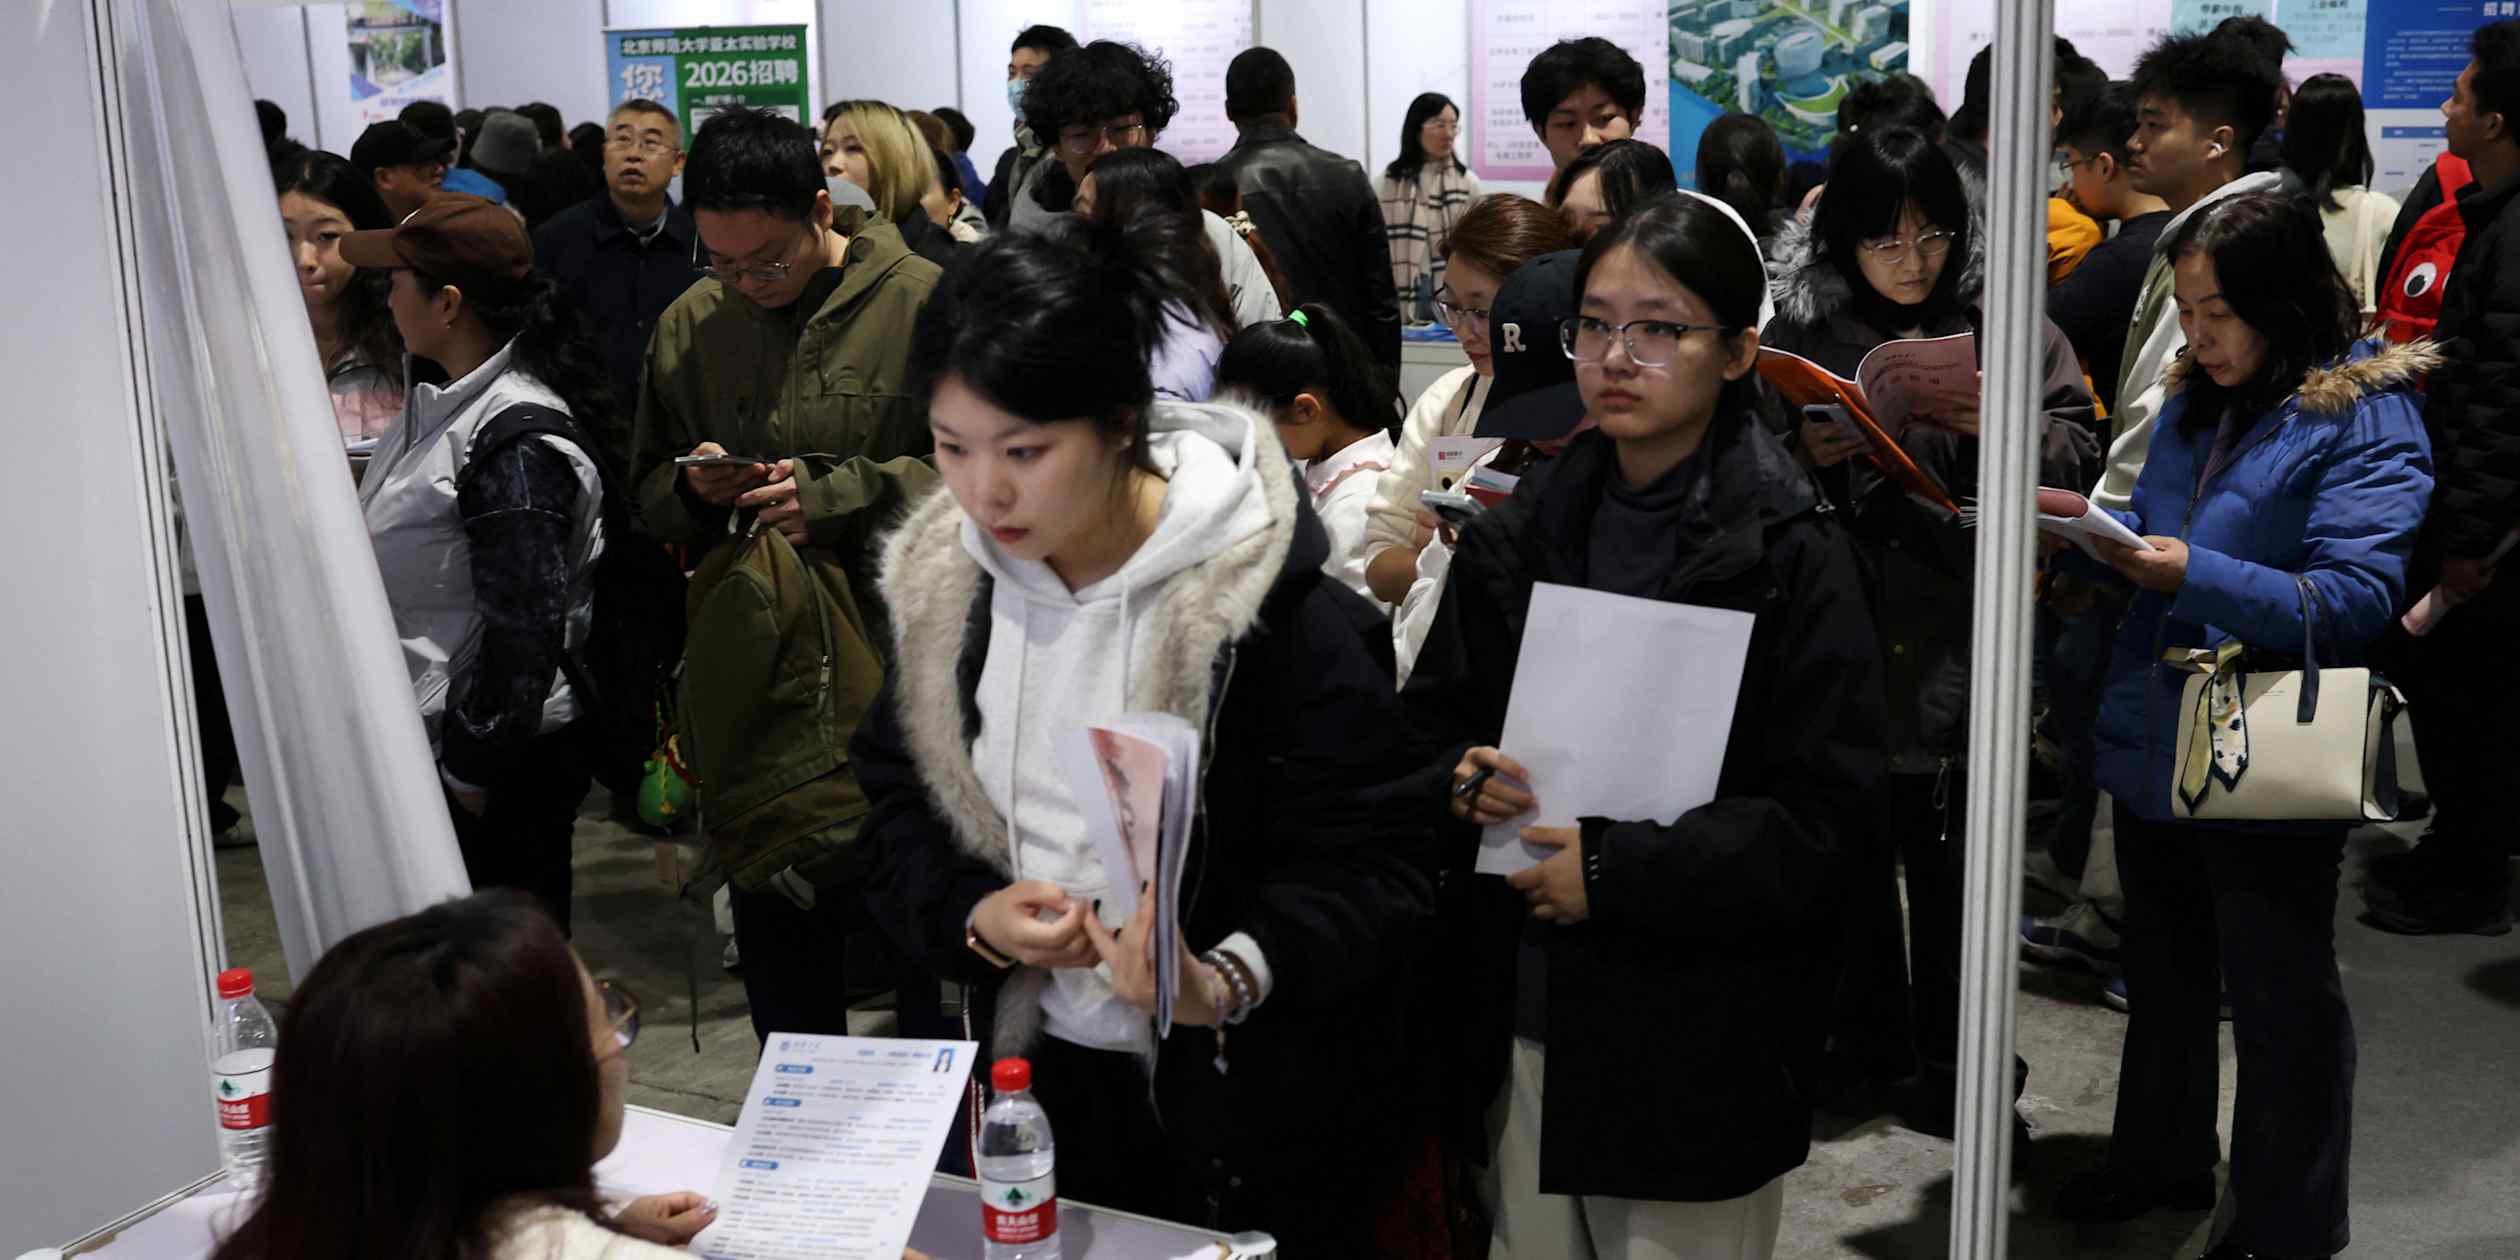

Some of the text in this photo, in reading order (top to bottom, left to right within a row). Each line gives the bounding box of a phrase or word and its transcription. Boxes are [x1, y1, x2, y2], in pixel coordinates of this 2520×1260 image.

[2483, 1, 2520, 16] 招聘
[685, 59, 799, 87] 2026招聘
[1502, 322, 1526, 353] R
